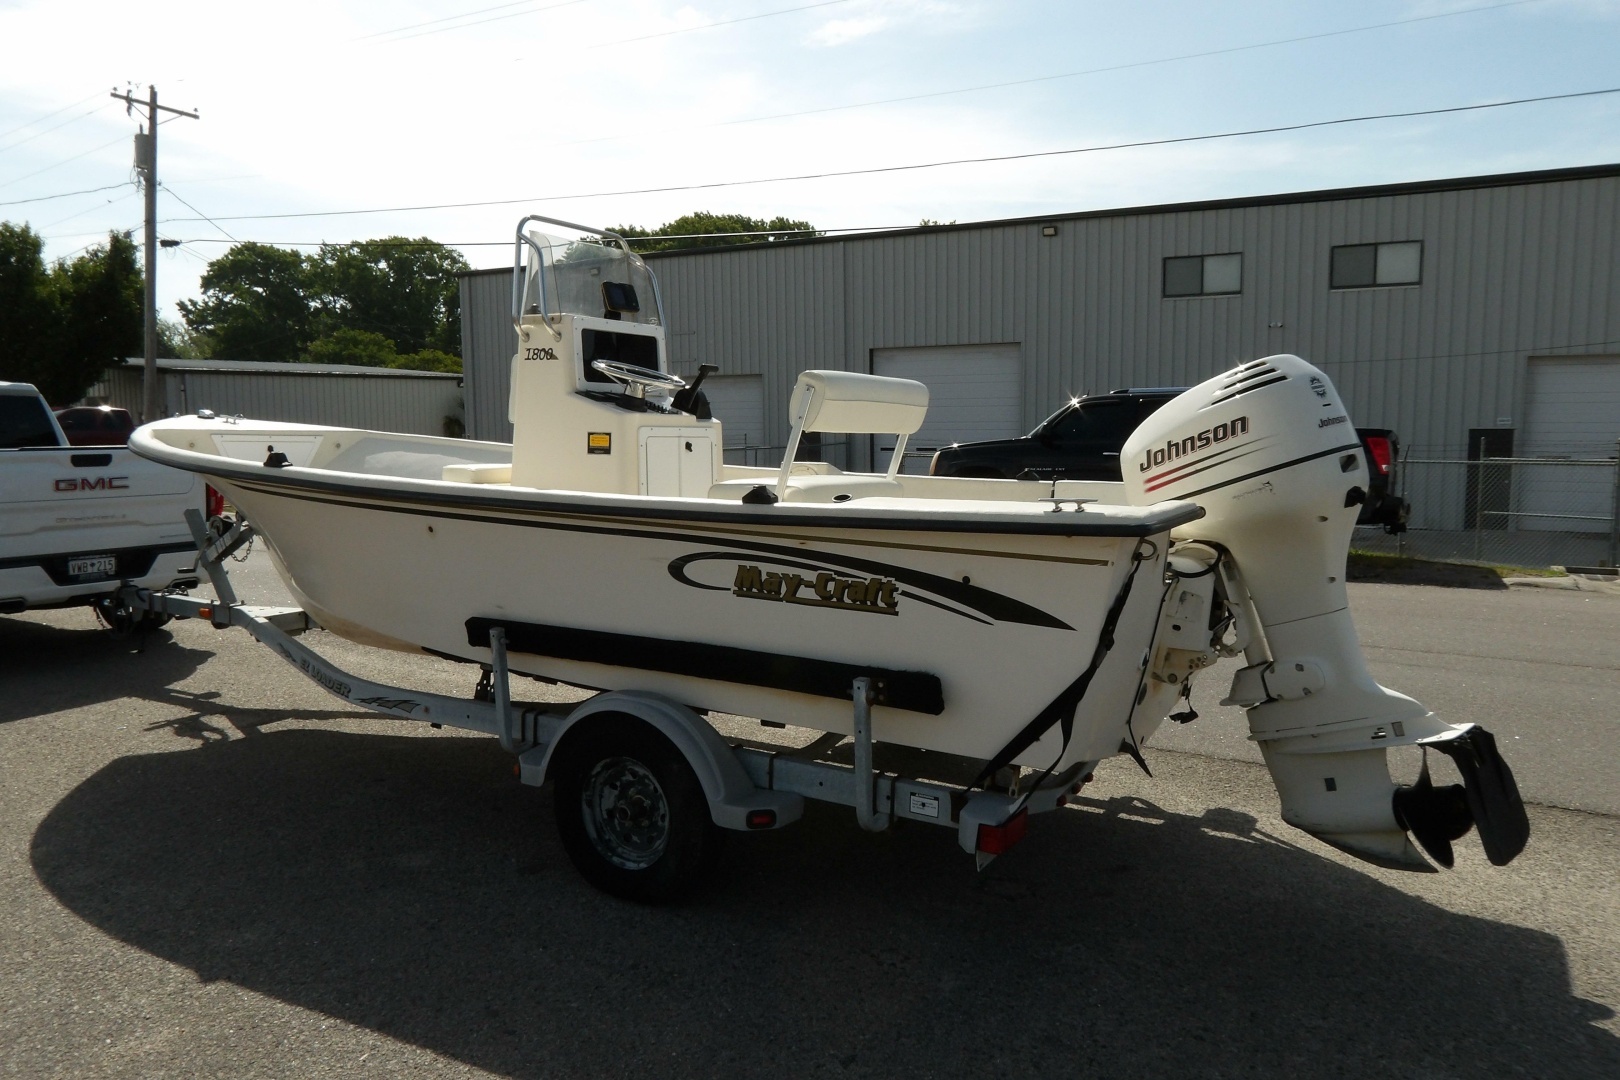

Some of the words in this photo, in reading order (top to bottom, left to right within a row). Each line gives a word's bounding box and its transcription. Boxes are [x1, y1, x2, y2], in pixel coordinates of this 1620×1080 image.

[524, 347, 554, 361] 1800
[1318, 415, 1348, 428] Johnson
[1139, 415, 1249, 474] Johnson
[54, 476, 130, 492] GMC
[97, 559, 114, 572] 215
[733, 564, 899, 609] May-Craft
[311, 664, 352, 699] LOADER
